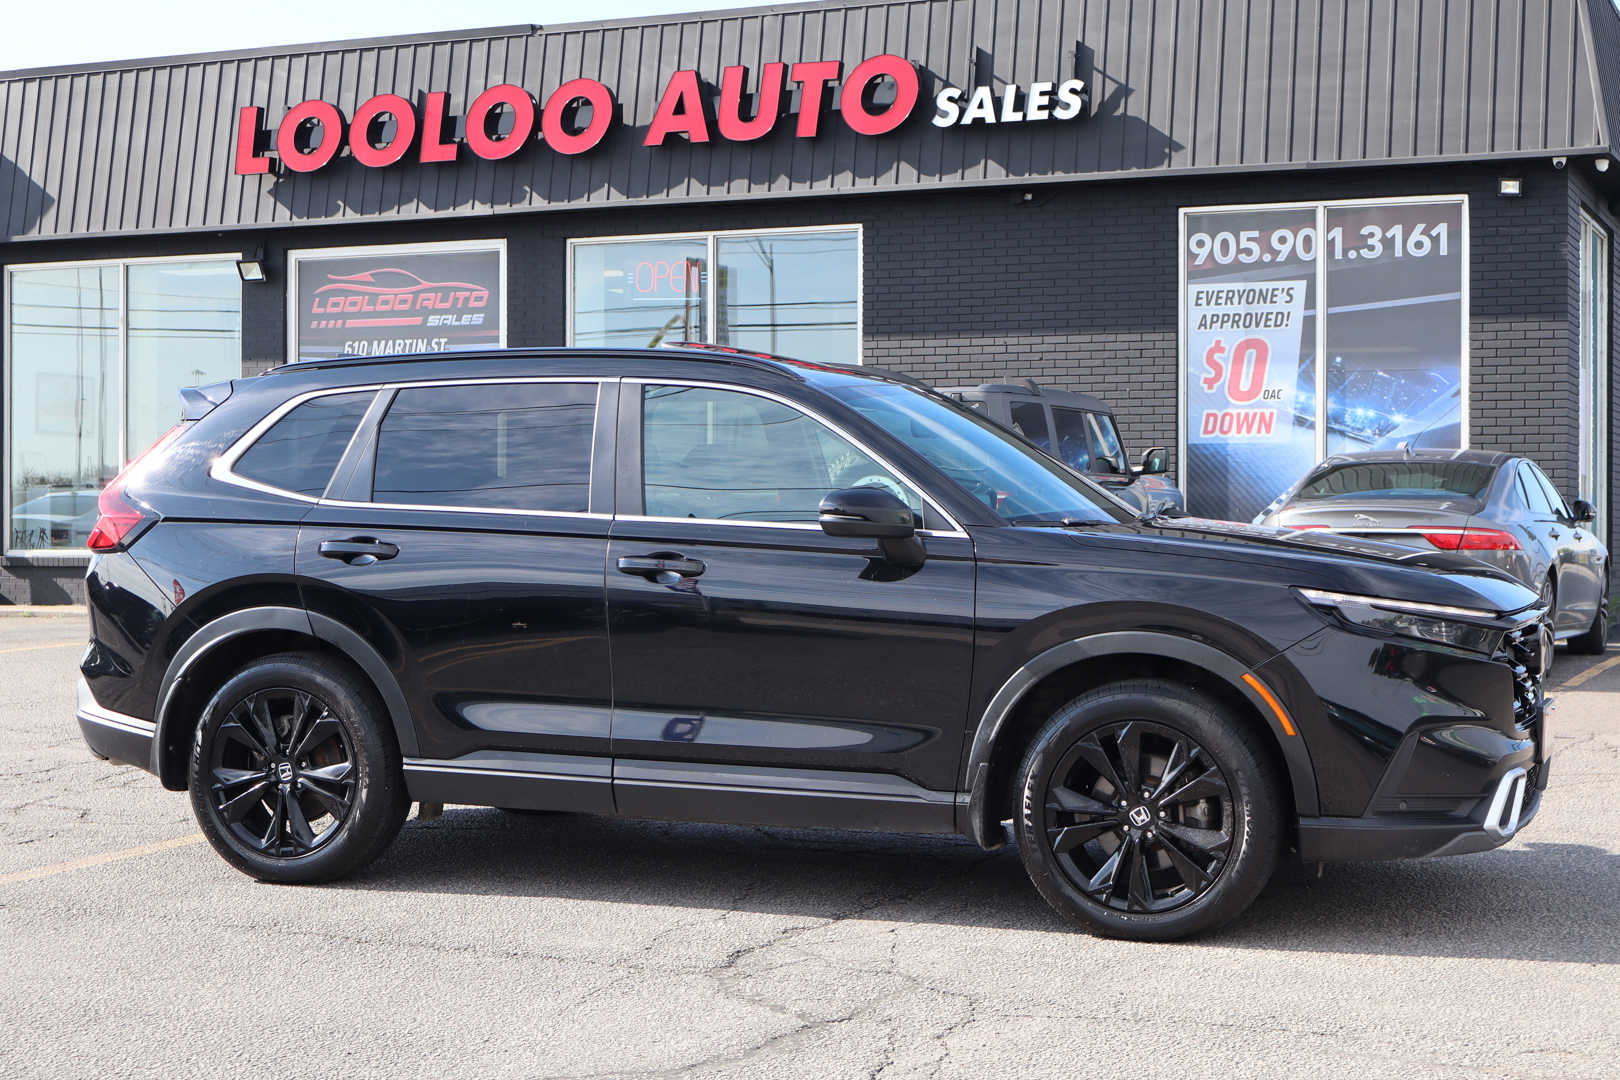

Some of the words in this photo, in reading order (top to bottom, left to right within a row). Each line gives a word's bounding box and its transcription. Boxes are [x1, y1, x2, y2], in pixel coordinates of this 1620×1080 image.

[235, 78, 614, 175] LOOLOO
[642, 54, 920, 147] AUTO
[931, 79, 1086, 128] SALES
[1188, 222, 1448, 266] 905.901.3161
[635, 261, 700, 292] OPEN
[311, 294, 414, 314] LOOLOO
[415, 290, 490, 310] AUTO
[1194, 287, 1295, 307] EVERYONE'S
[426, 313, 486, 327] SALES
[1197, 311, 1291, 331] APPROVED!
[344, 340, 369, 356] 610
[371, 338, 428, 356] MARTIN
[1202, 338, 1269, 402] $0
[1262, 389, 1283, 400] OAC
[1202, 411, 1275, 435] DOWN
